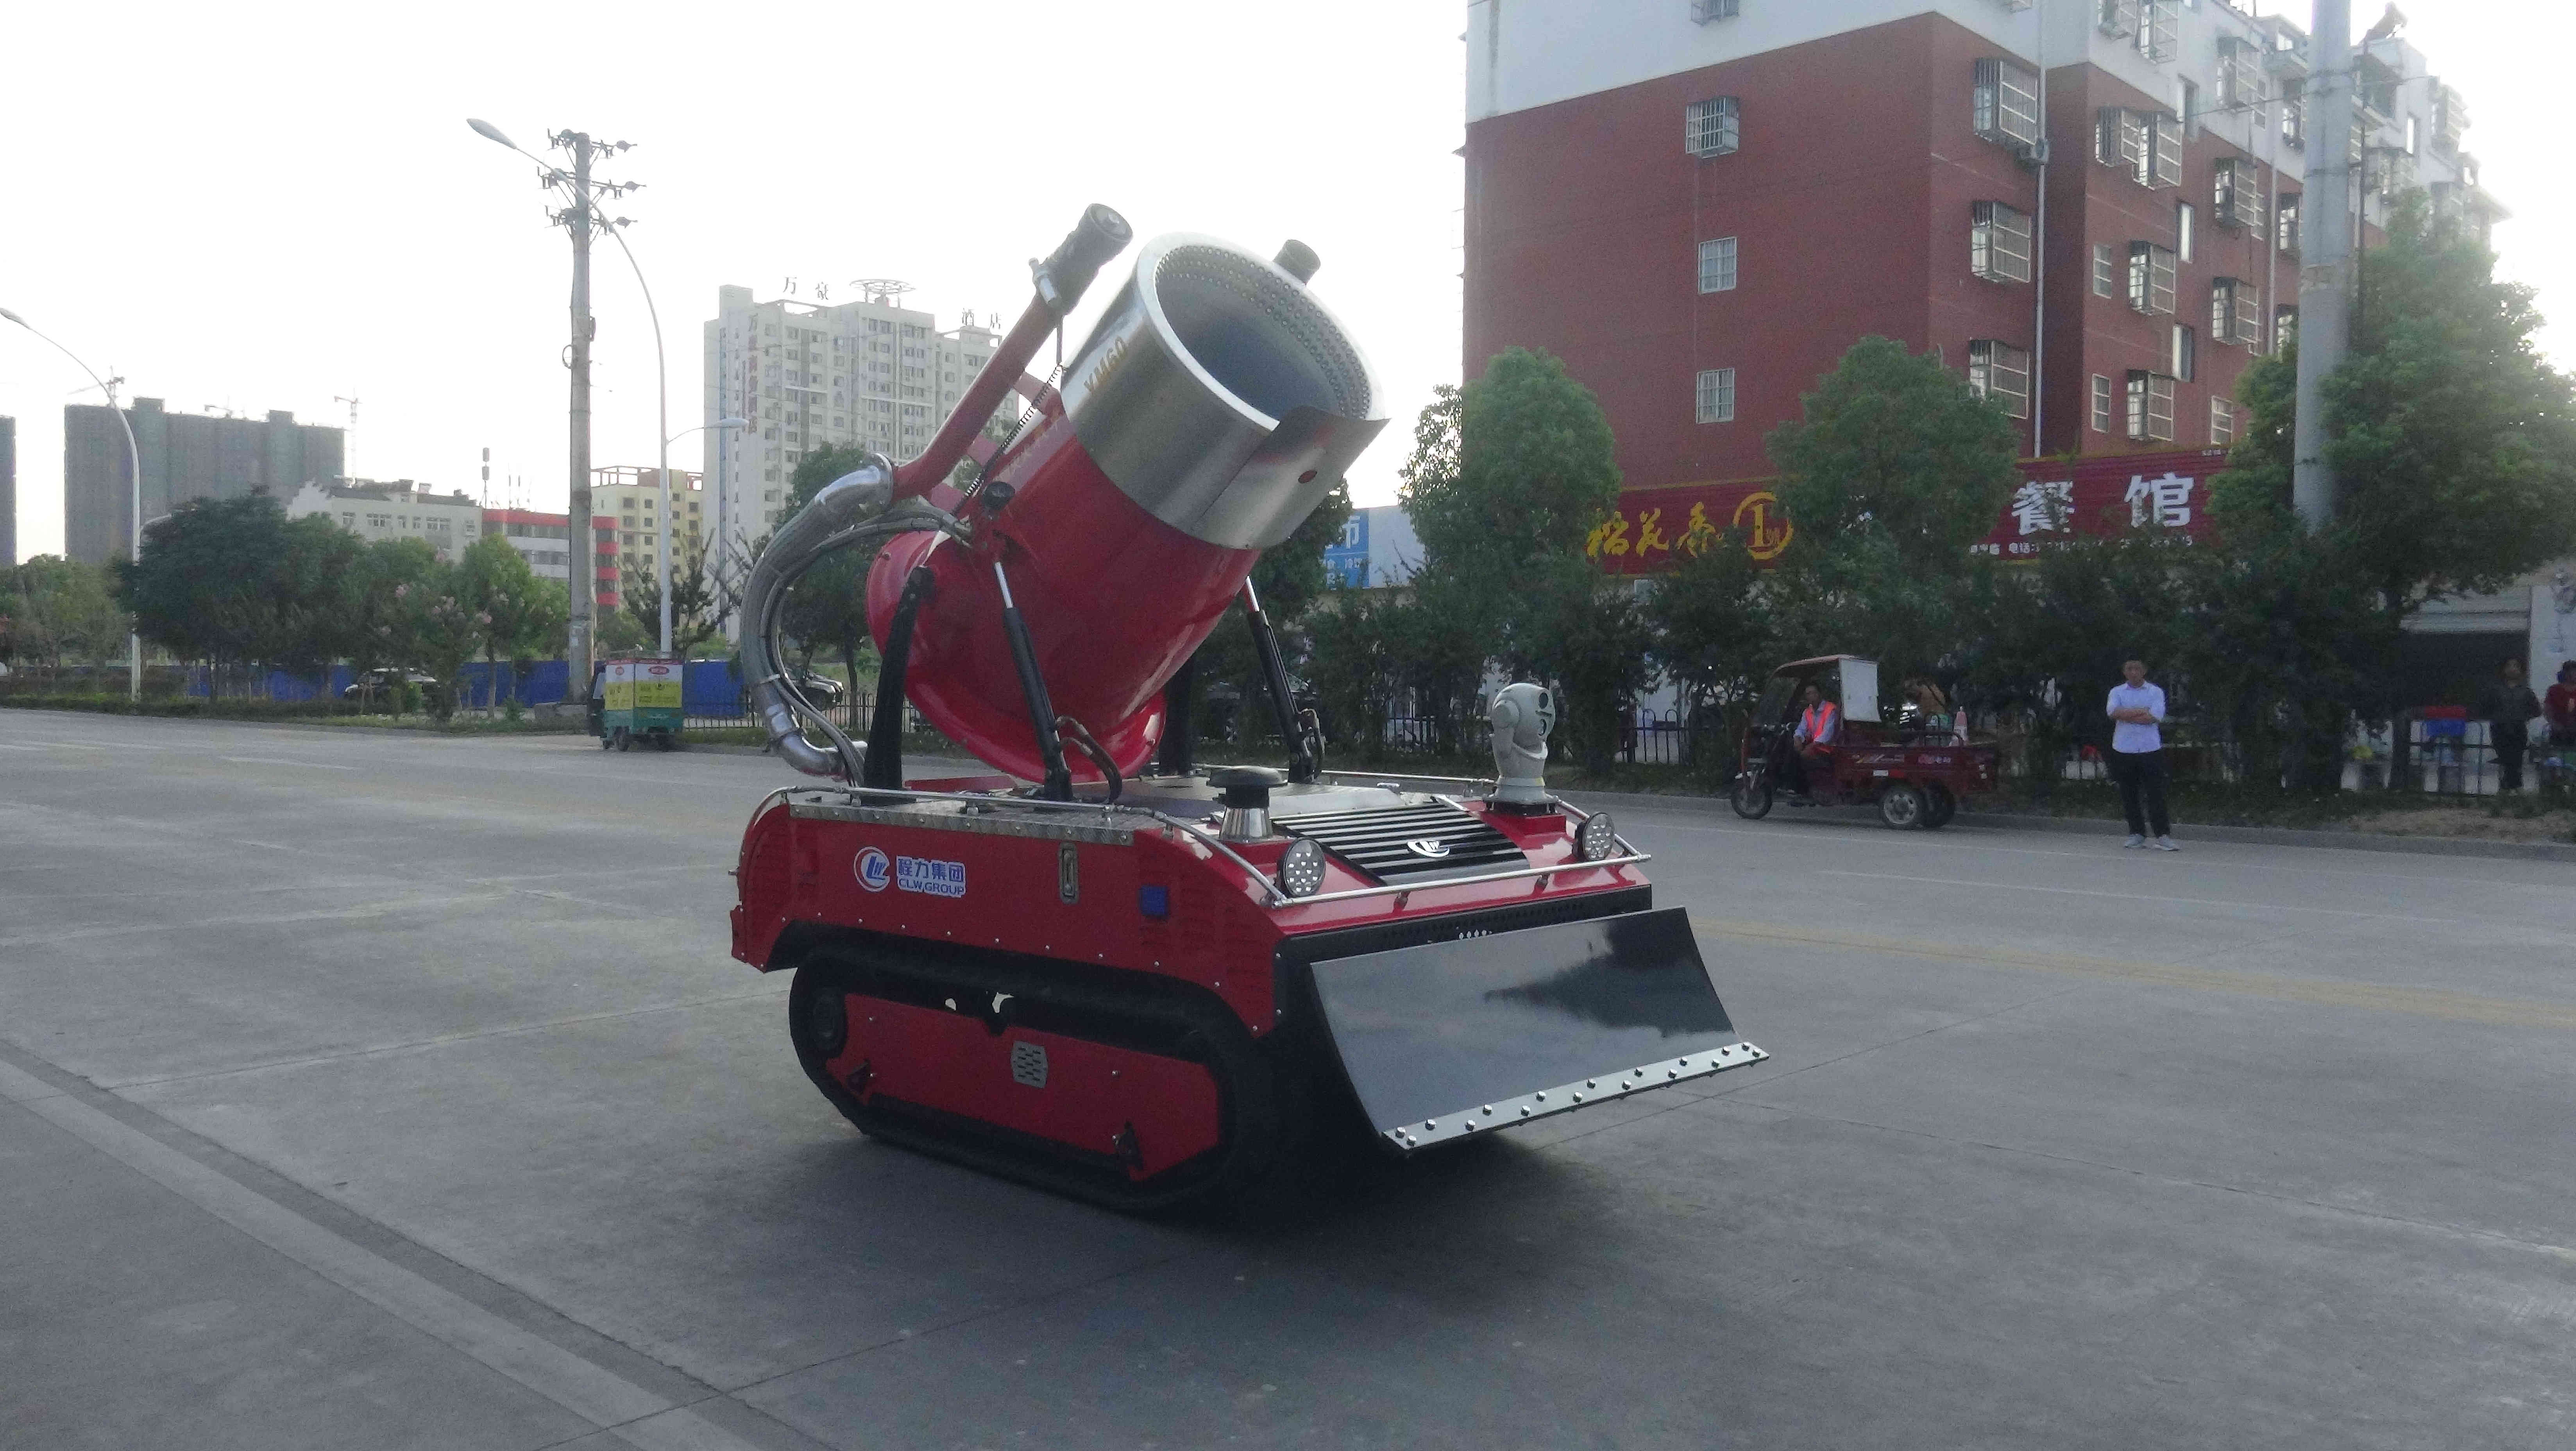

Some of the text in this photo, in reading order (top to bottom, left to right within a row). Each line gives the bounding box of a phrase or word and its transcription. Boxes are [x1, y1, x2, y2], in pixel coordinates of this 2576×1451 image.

[2011, 472, 2195, 536] 餐馆
[898, 858, 964, 882] 程力集团
